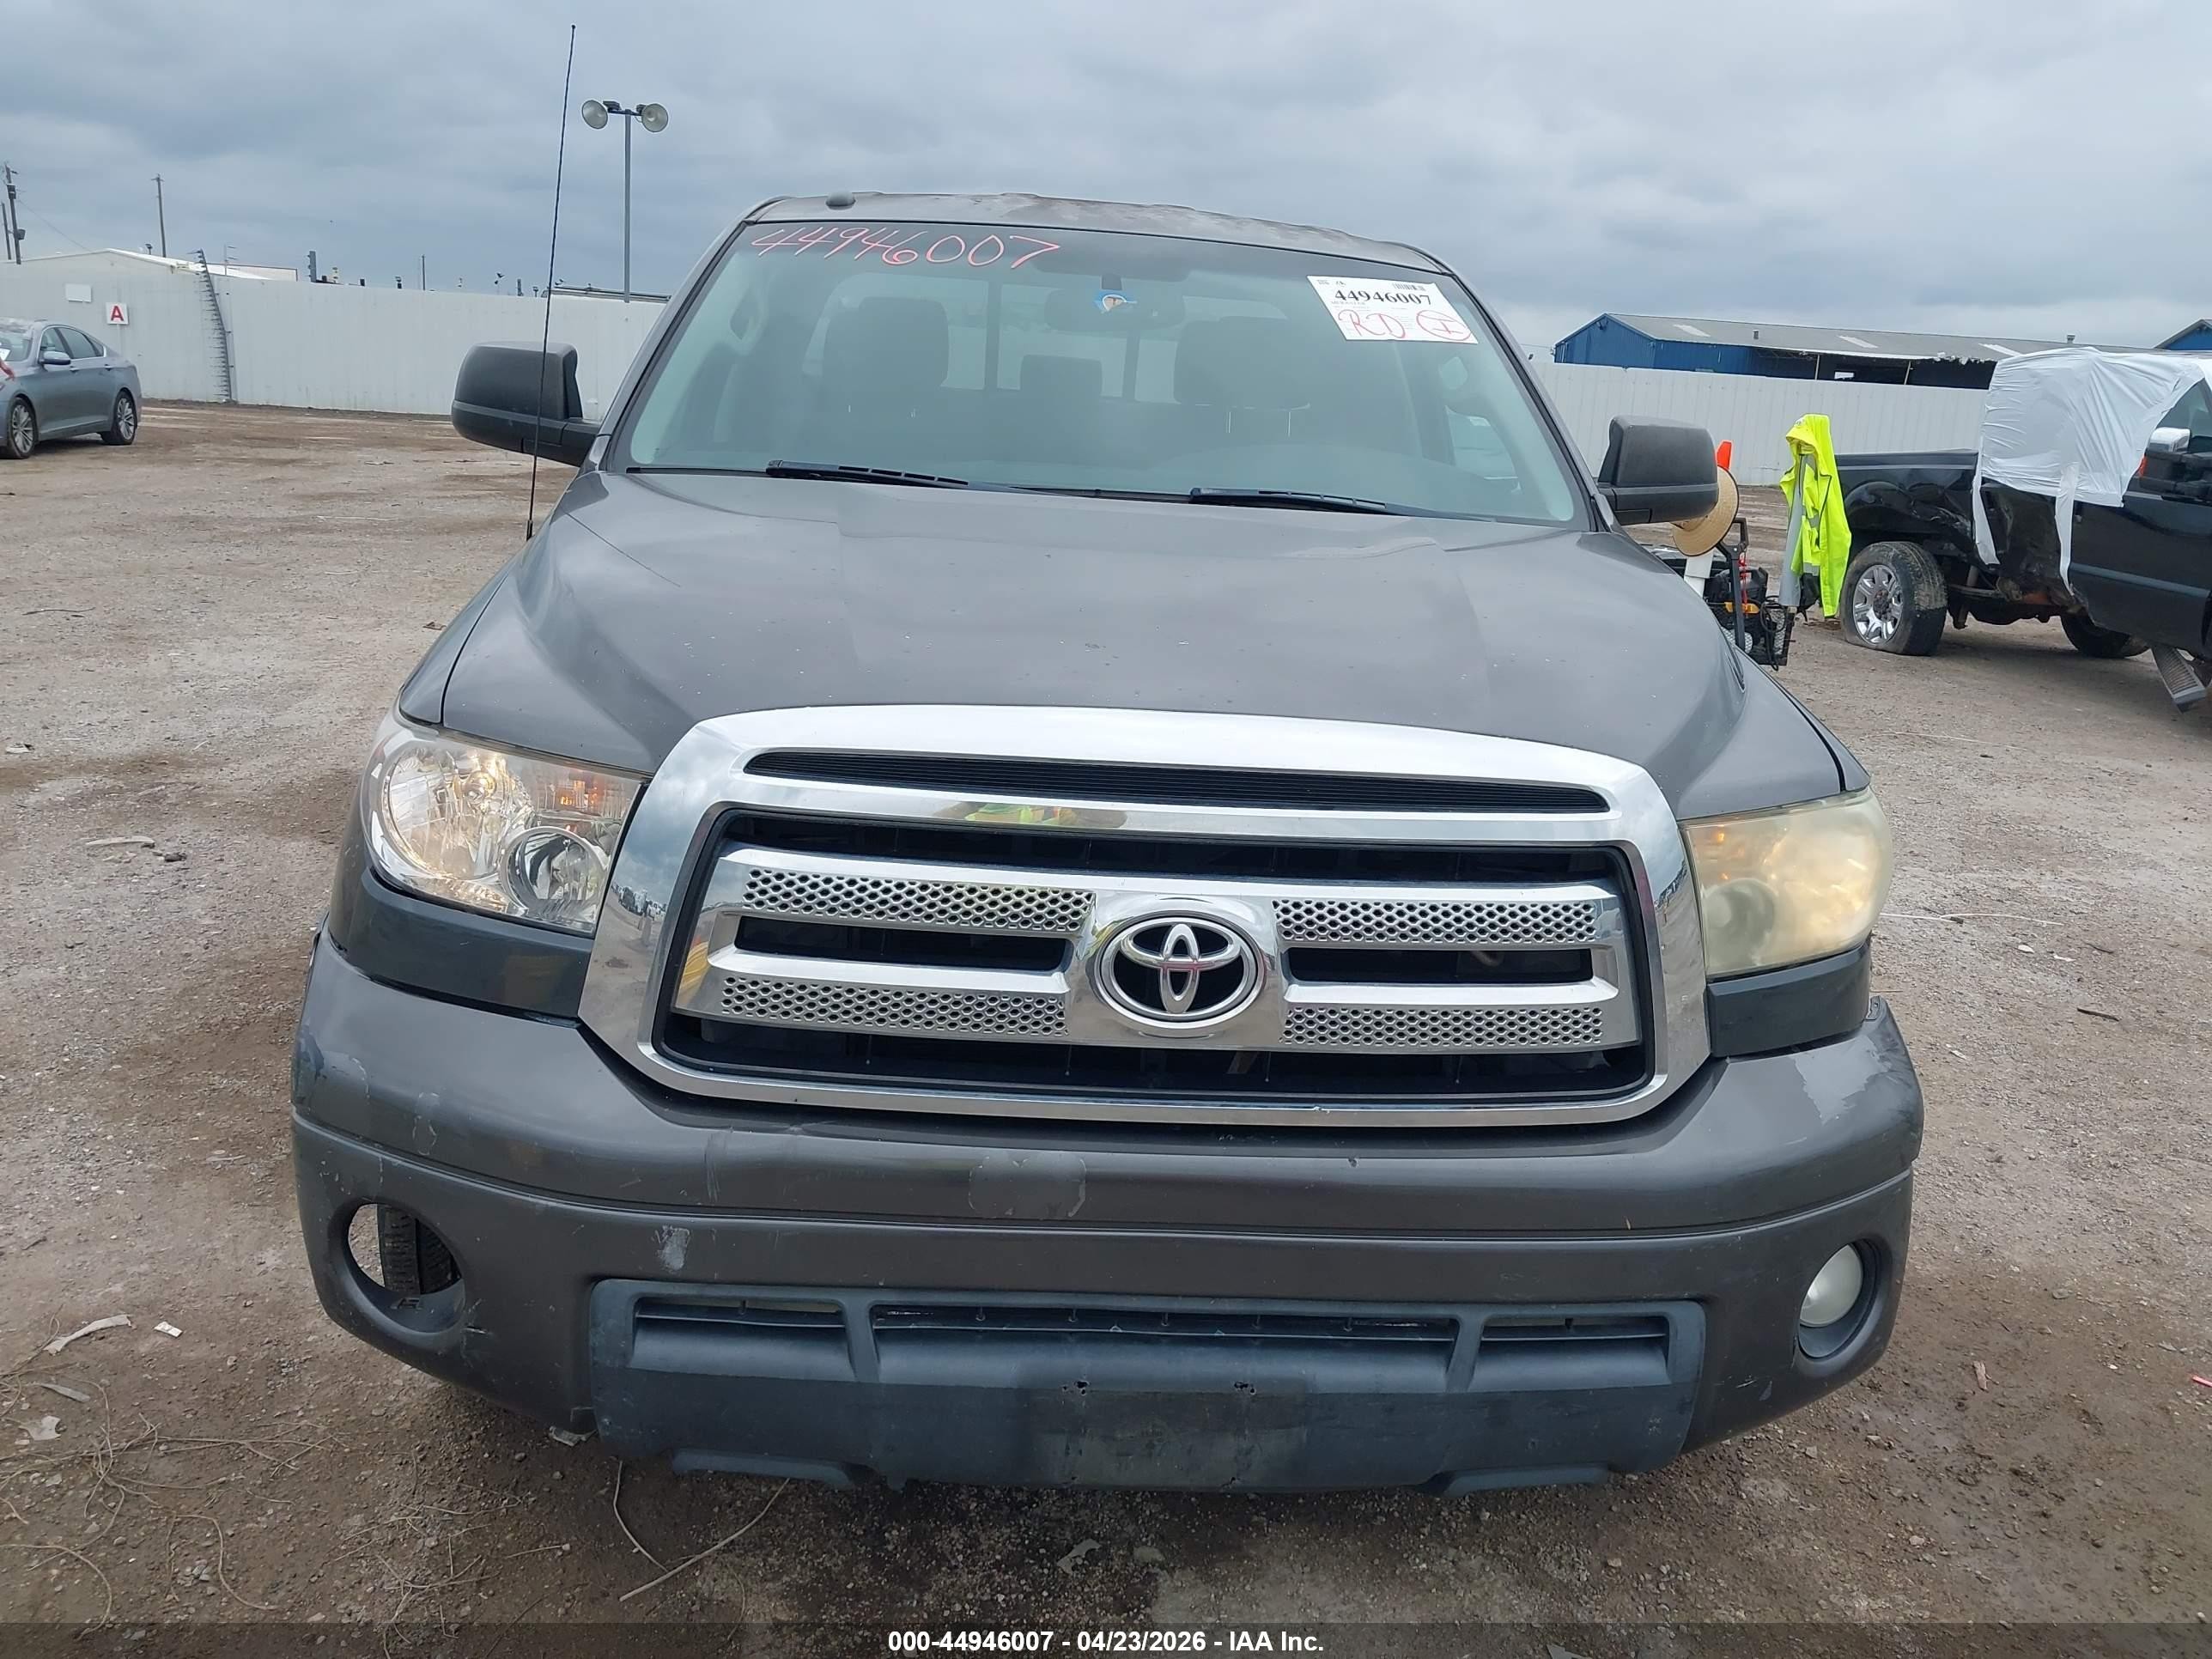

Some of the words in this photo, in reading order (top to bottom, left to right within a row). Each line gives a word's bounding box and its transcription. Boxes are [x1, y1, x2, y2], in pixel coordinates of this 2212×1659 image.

[750, 227, 1060, 269] 44946007
[1334, 289, 1431, 305] 44946007
[111, 305, 125, 321] A
